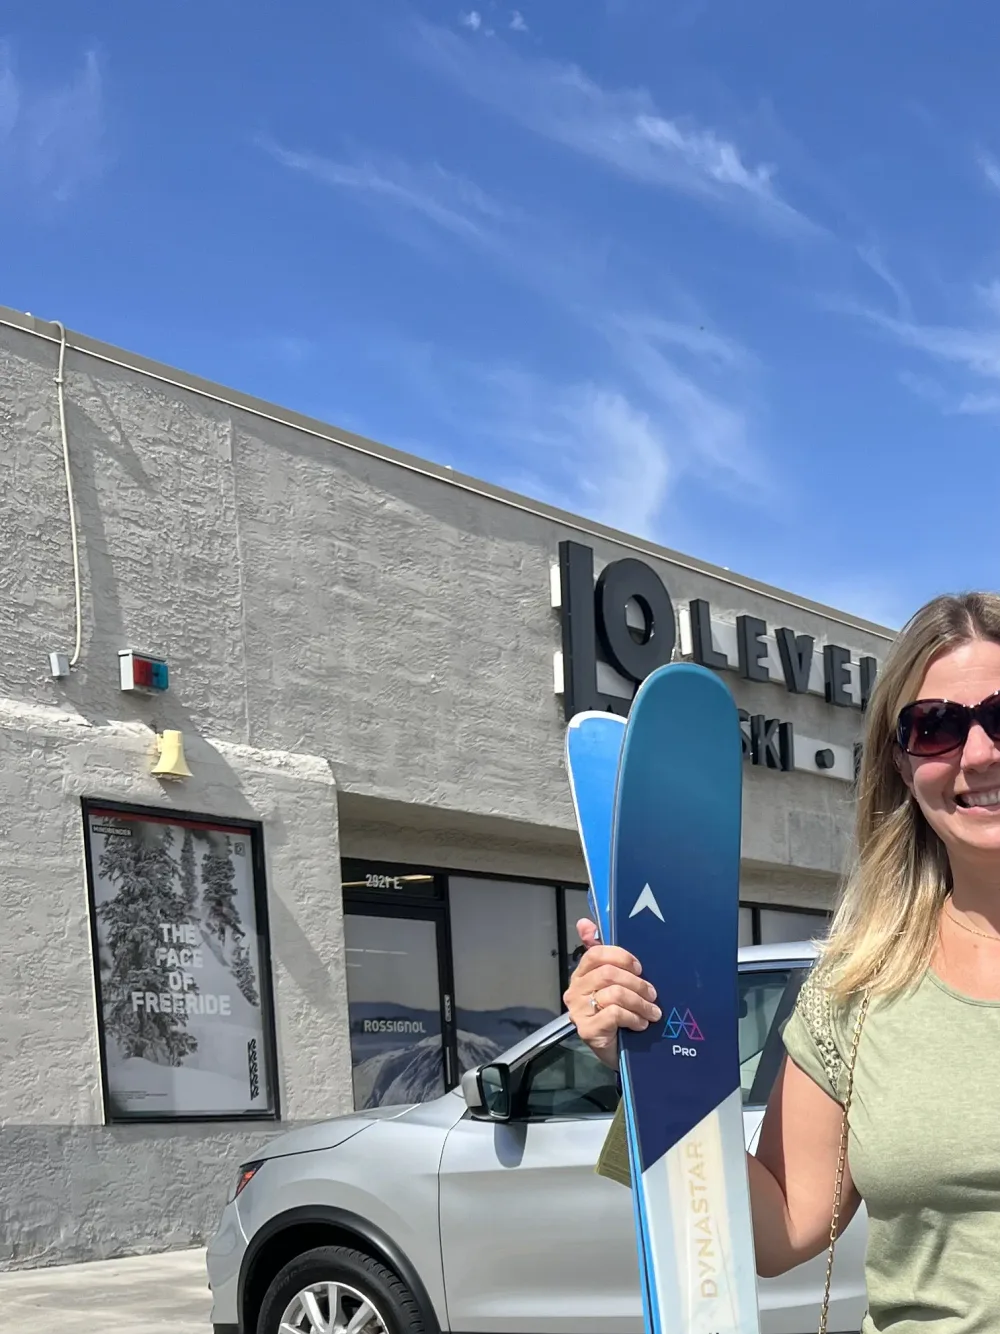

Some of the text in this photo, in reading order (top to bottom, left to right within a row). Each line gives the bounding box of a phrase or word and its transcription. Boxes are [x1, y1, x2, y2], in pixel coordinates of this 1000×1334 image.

[160, 922, 198, 945] THE
[155, 946, 203, 968] FACE
[169, 970, 195, 991] OF
[131, 991, 232, 1016] FREERIDE
[364, 1020, 426, 1033] ROSSIGNOL
[686, 1141, 718, 1298] DYNASTAR
